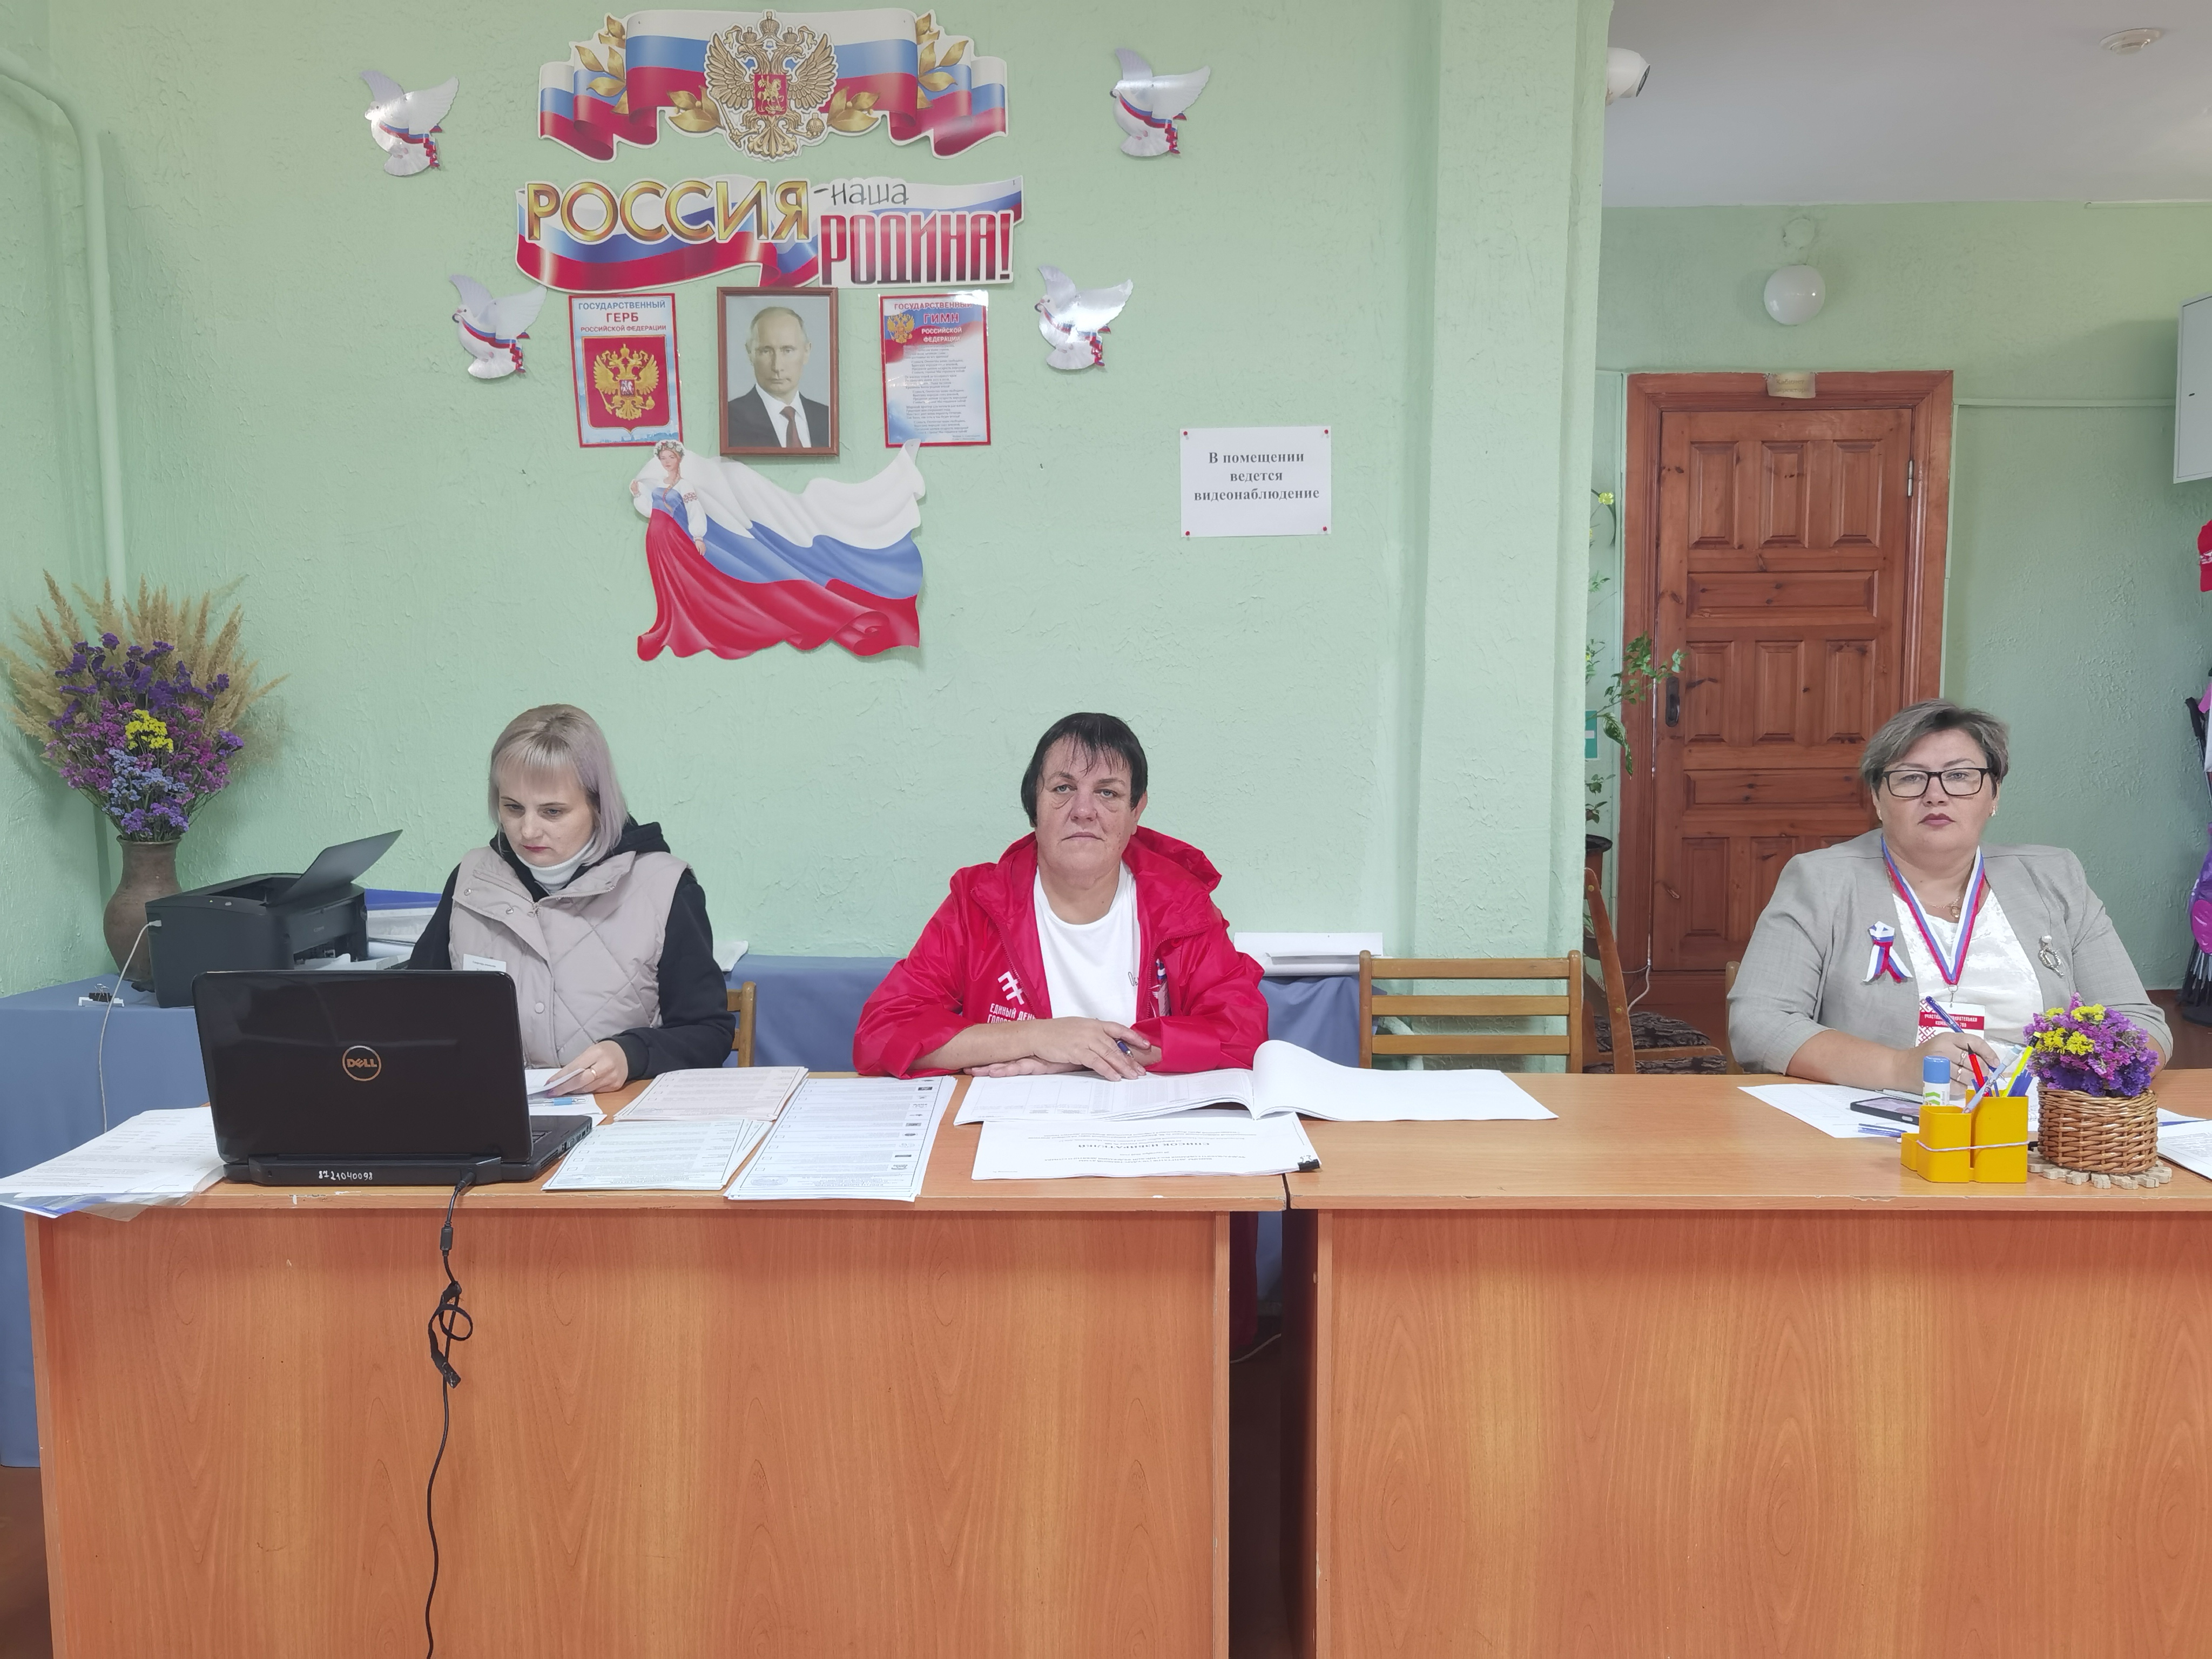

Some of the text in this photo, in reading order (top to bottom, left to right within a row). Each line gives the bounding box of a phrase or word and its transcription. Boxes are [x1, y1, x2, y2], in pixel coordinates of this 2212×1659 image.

[525, 180, 810, 242] РОССИЯ
[820, 213, 1013, 286] РОДИНА!
[578, 300, 666, 311] ГОСУДАРСТВЕННЫЙ
[606, 312, 639, 322] ГЕРБ
[923, 313, 960, 324] ГИМН
[1209, 452, 1304, 464] В помещении
[1230, 471, 1283, 483] ведется
[1194, 488, 1320, 502] видеонаблюдение
[989, 1003, 1016, 1019] ЕДИНЫЙ
[346, 1058, 377, 1068] DELL
